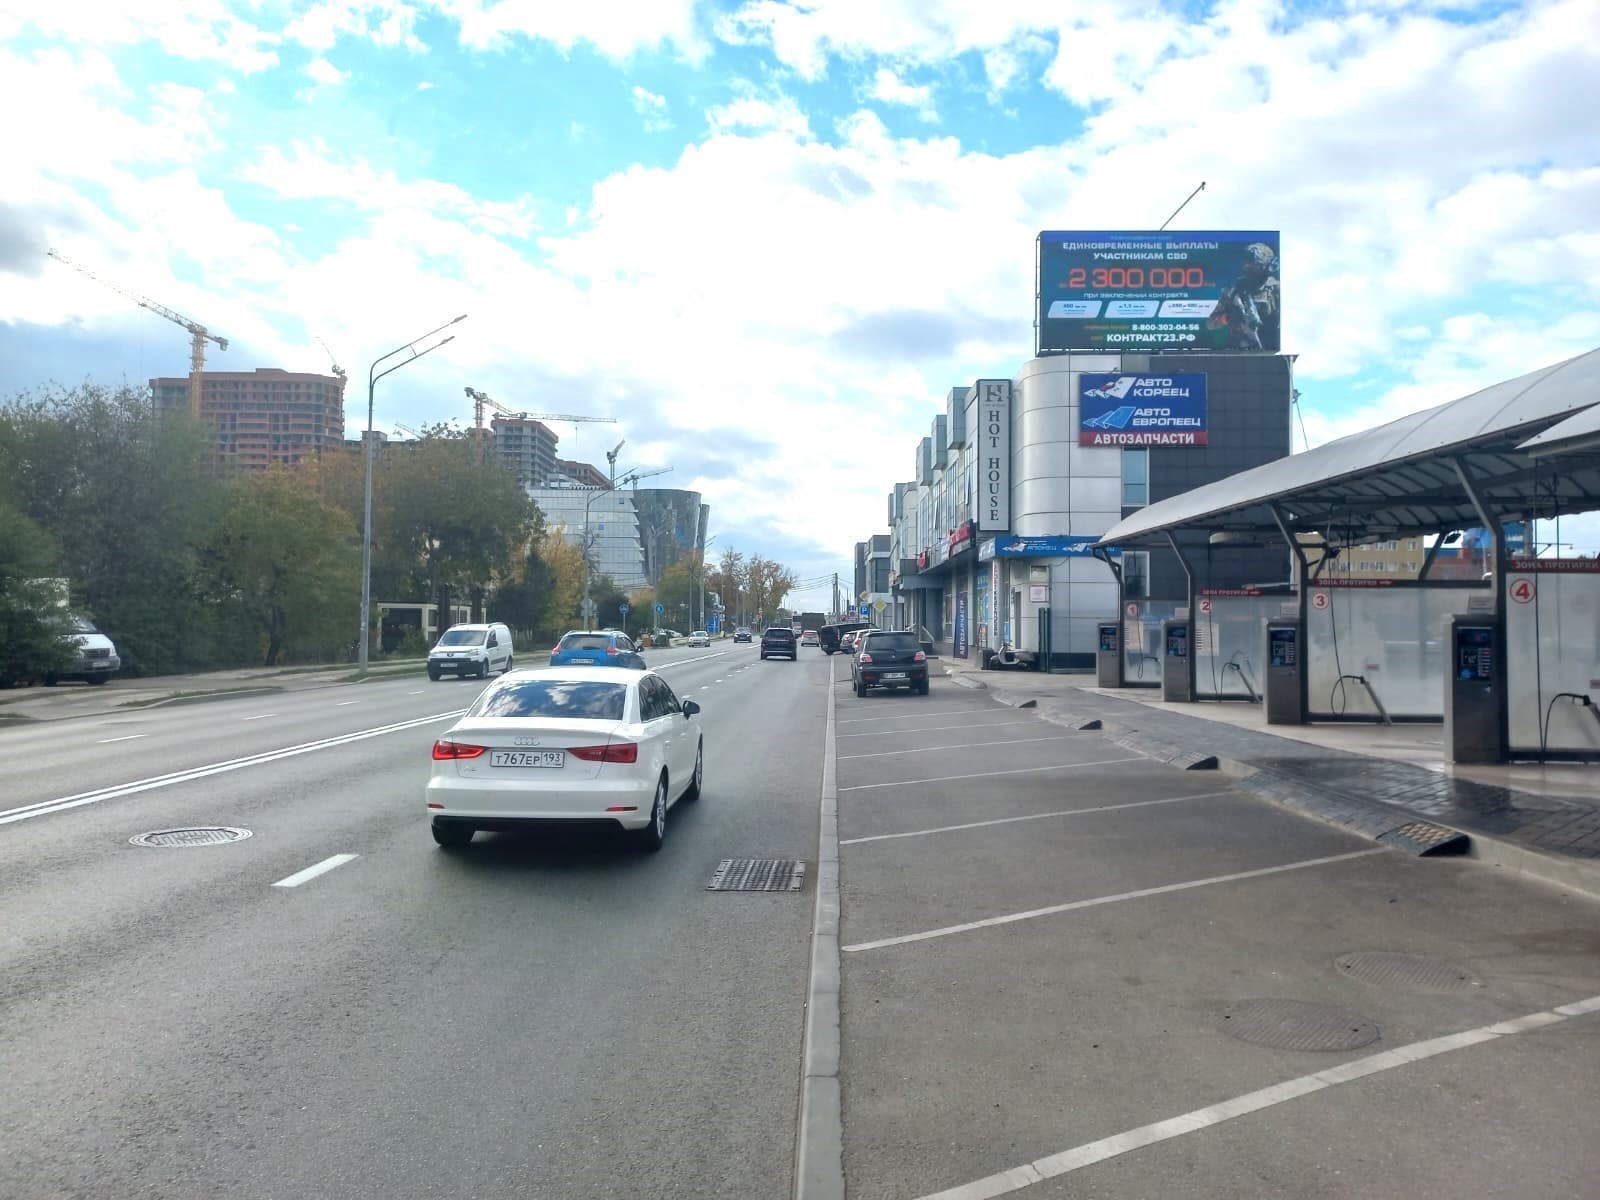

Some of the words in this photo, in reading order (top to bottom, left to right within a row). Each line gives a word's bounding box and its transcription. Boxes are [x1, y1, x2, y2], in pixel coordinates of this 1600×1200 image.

[1063, 242, 1162, 250] ЕДИНОВРЕМЕННЫЕ
[1093, 252, 1163, 260] УЧАСТНИКАМ
[1167, 252, 1187, 260] СВО
[1069, 268, 1086, 288] 2
[1092, 268, 1144, 288] 300
[1150, 268, 1203, 288] 000
[1106, 333, 1196, 342] КОНТРАКТ23.РФ
[1135, 378, 1172, 387] АВТО
[1133, 388, 1190, 397] КОРЕЕЦ
[1134, 408, 1170, 416] АВТО
[1132, 417, 1201, 427] ЕВРОПЕЕЦ
[988, 411, 1000, 448] HOT
[1094, 433, 1194, 444] АВТОЗАПЧАСТИ
[988, 457, 1000, 521] HOUSE
[1515, 561, 1543, 569] ЗОНА
[1545, 561, 1599, 569] ПРОТИРКИ
[1515, 583, 1530, 599] 4
[1316, 595, 1326, 607] 3
[1202, 601, 1210, 611] 2
[543, 753, 561, 762] 193
